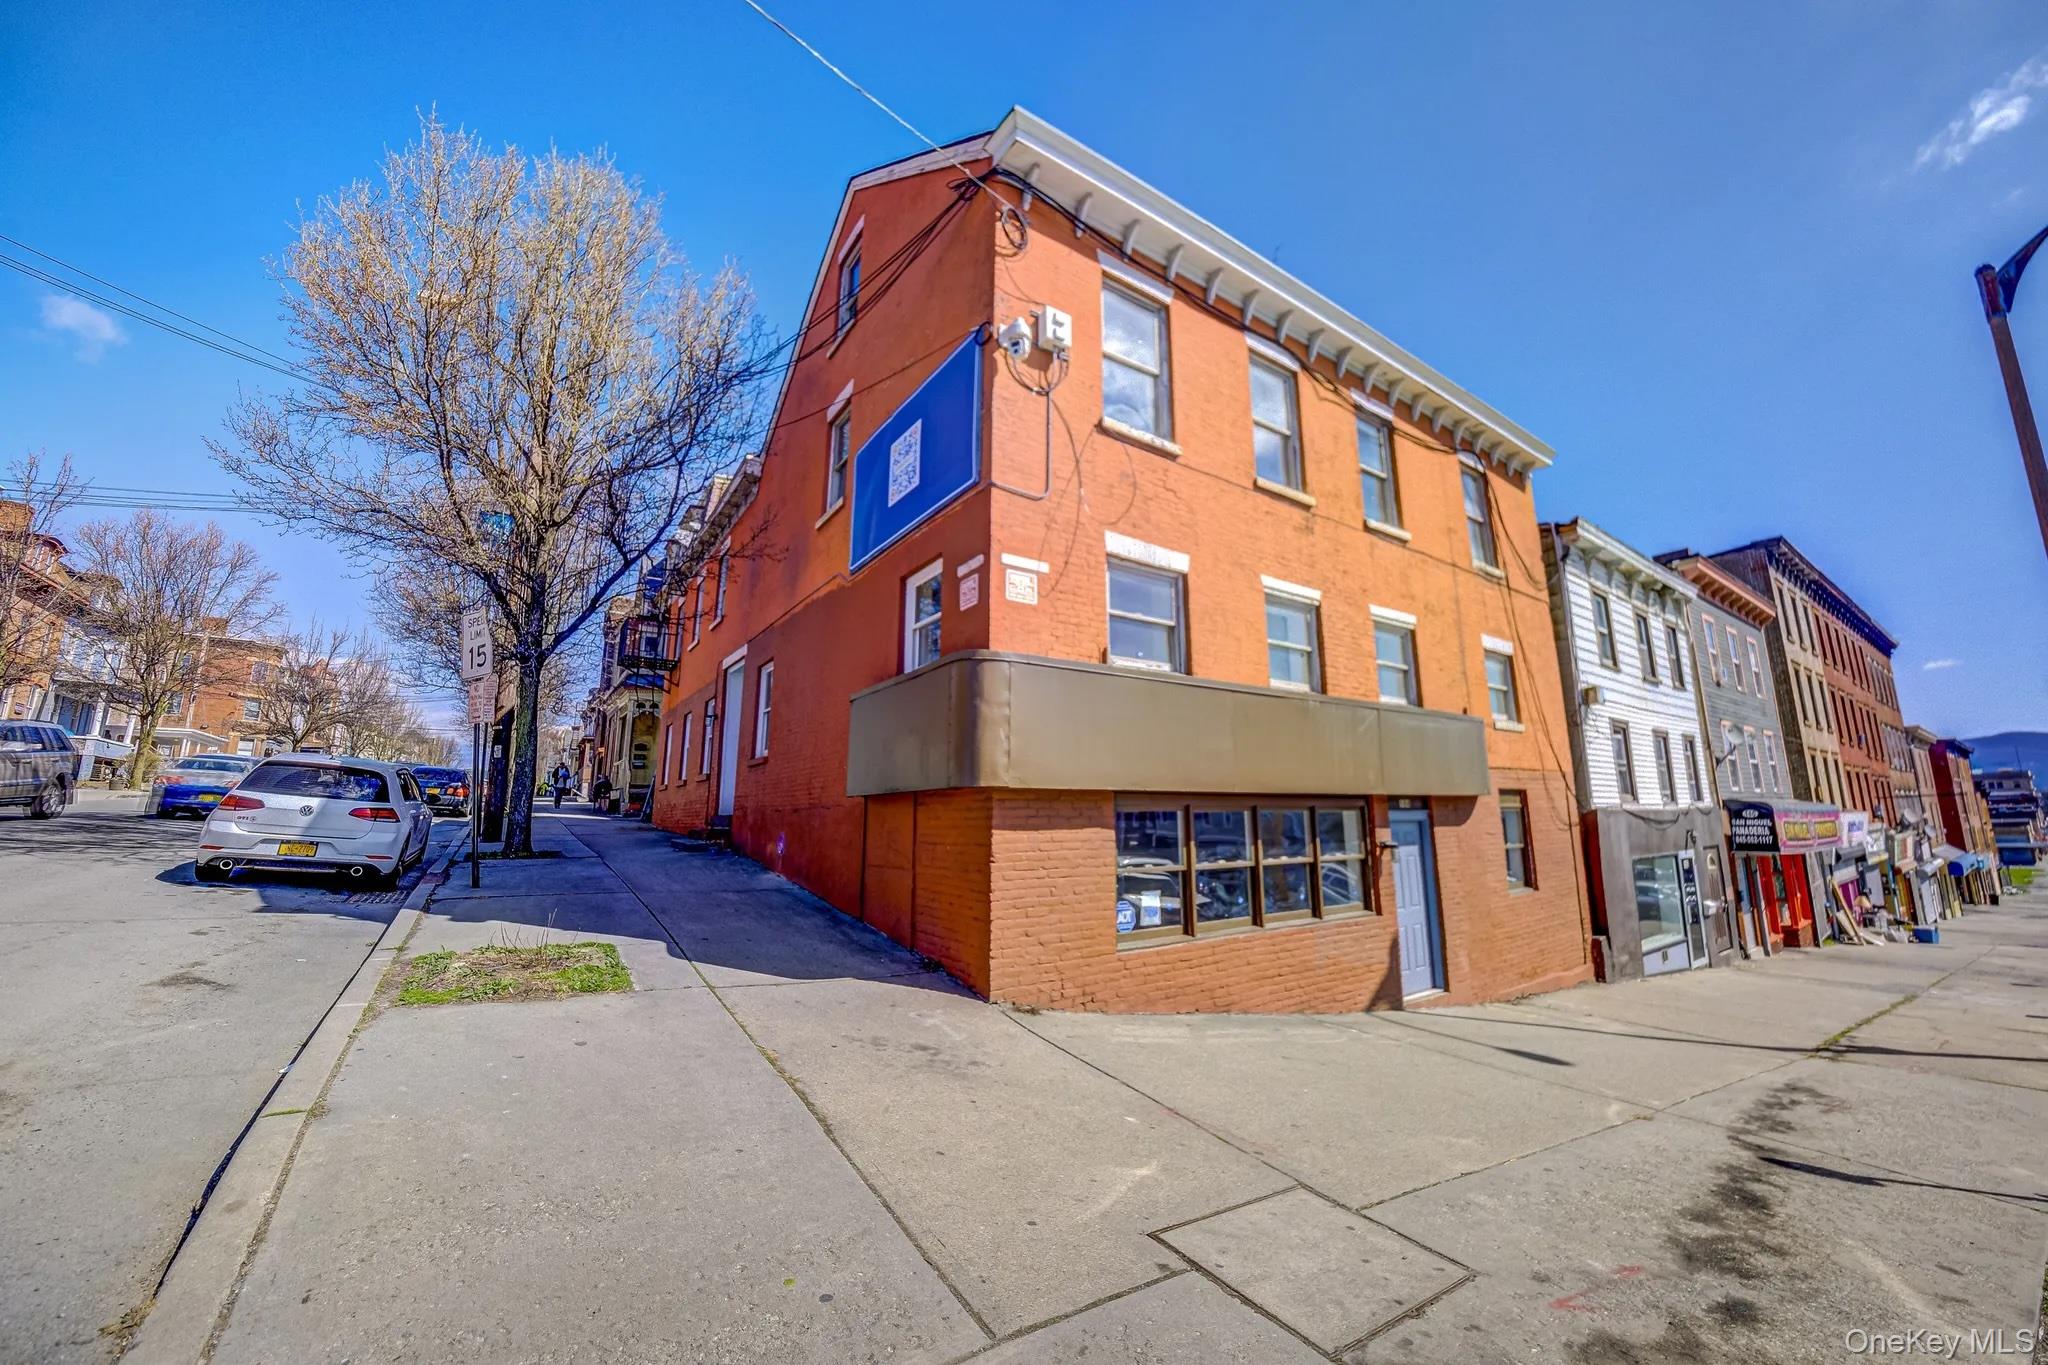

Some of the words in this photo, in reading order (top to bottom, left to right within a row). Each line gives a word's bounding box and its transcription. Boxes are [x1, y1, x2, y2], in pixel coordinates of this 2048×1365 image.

[469, 643, 487, 670] 15
[1746, 818, 1772, 826] MIGUEL
[1732, 826, 1770, 835] PANADERIA
